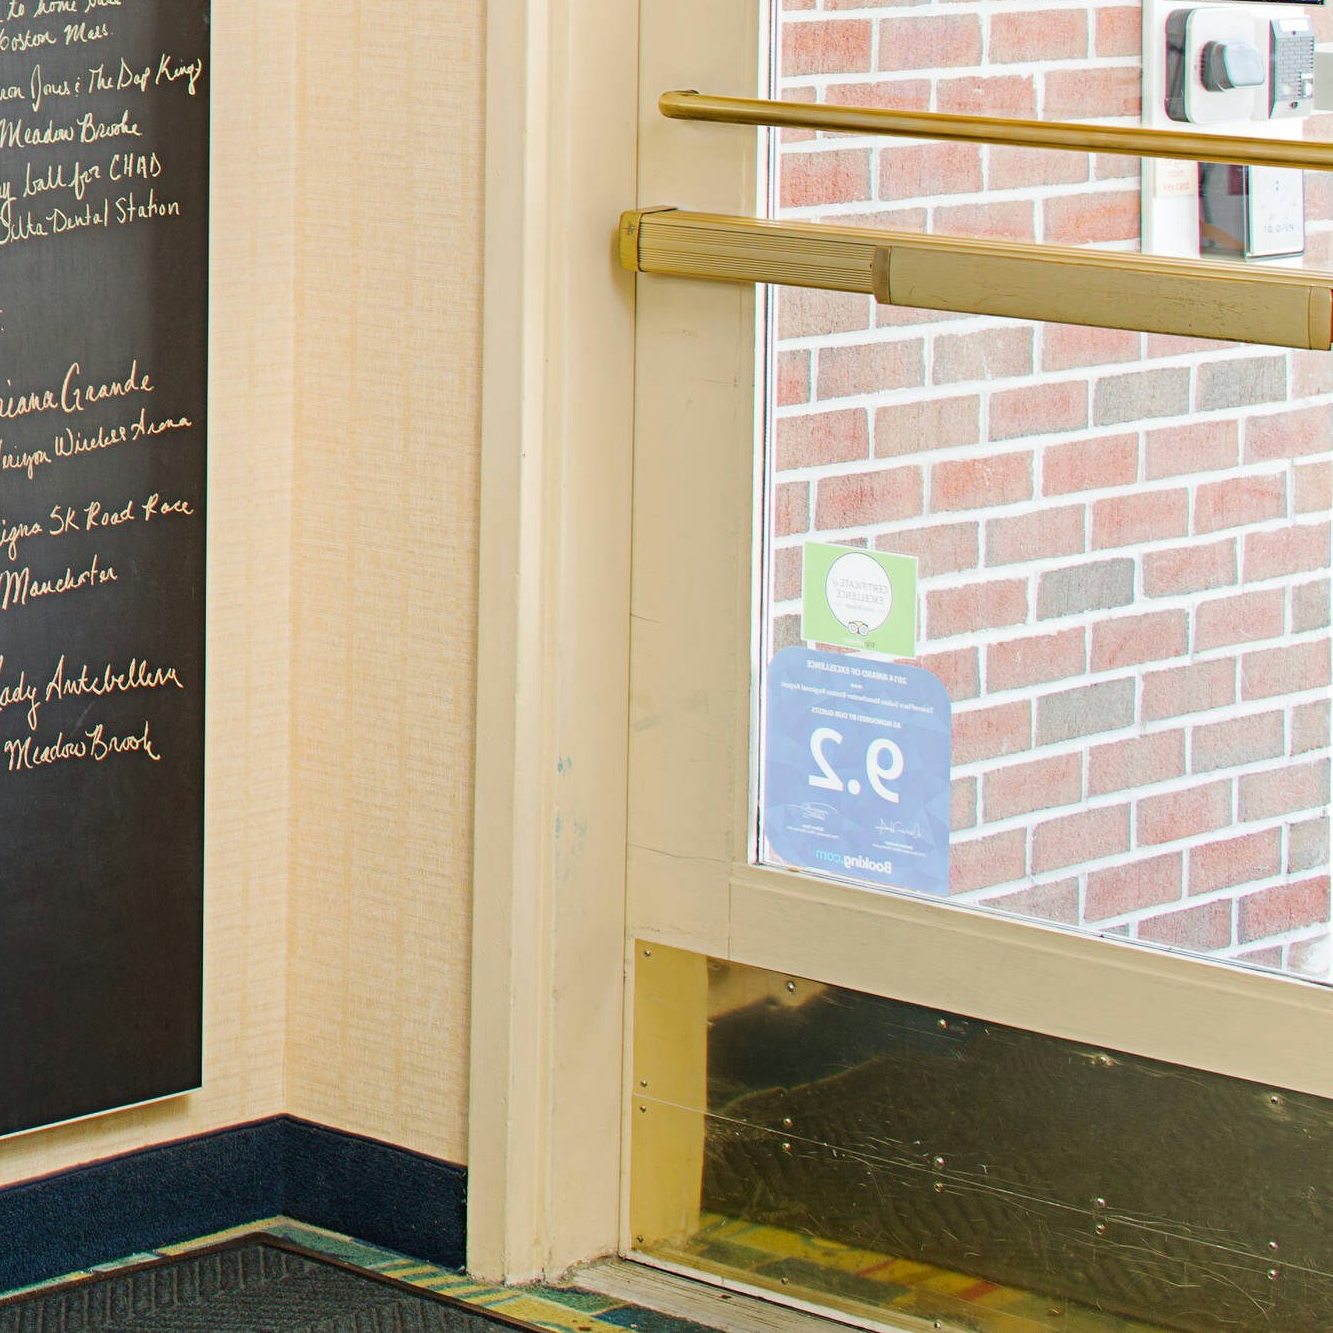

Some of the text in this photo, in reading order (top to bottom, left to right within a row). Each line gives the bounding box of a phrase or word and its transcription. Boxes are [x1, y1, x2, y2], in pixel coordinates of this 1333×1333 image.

[23, 162, 66, 197] ball
[110, 152, 162, 180] CHAD
[46, 198, 108, 233] Dental
[61, 359, 155, 413] Grande
[84, 500, 134, 531] Road
[142, 493, 194, 521] Race
